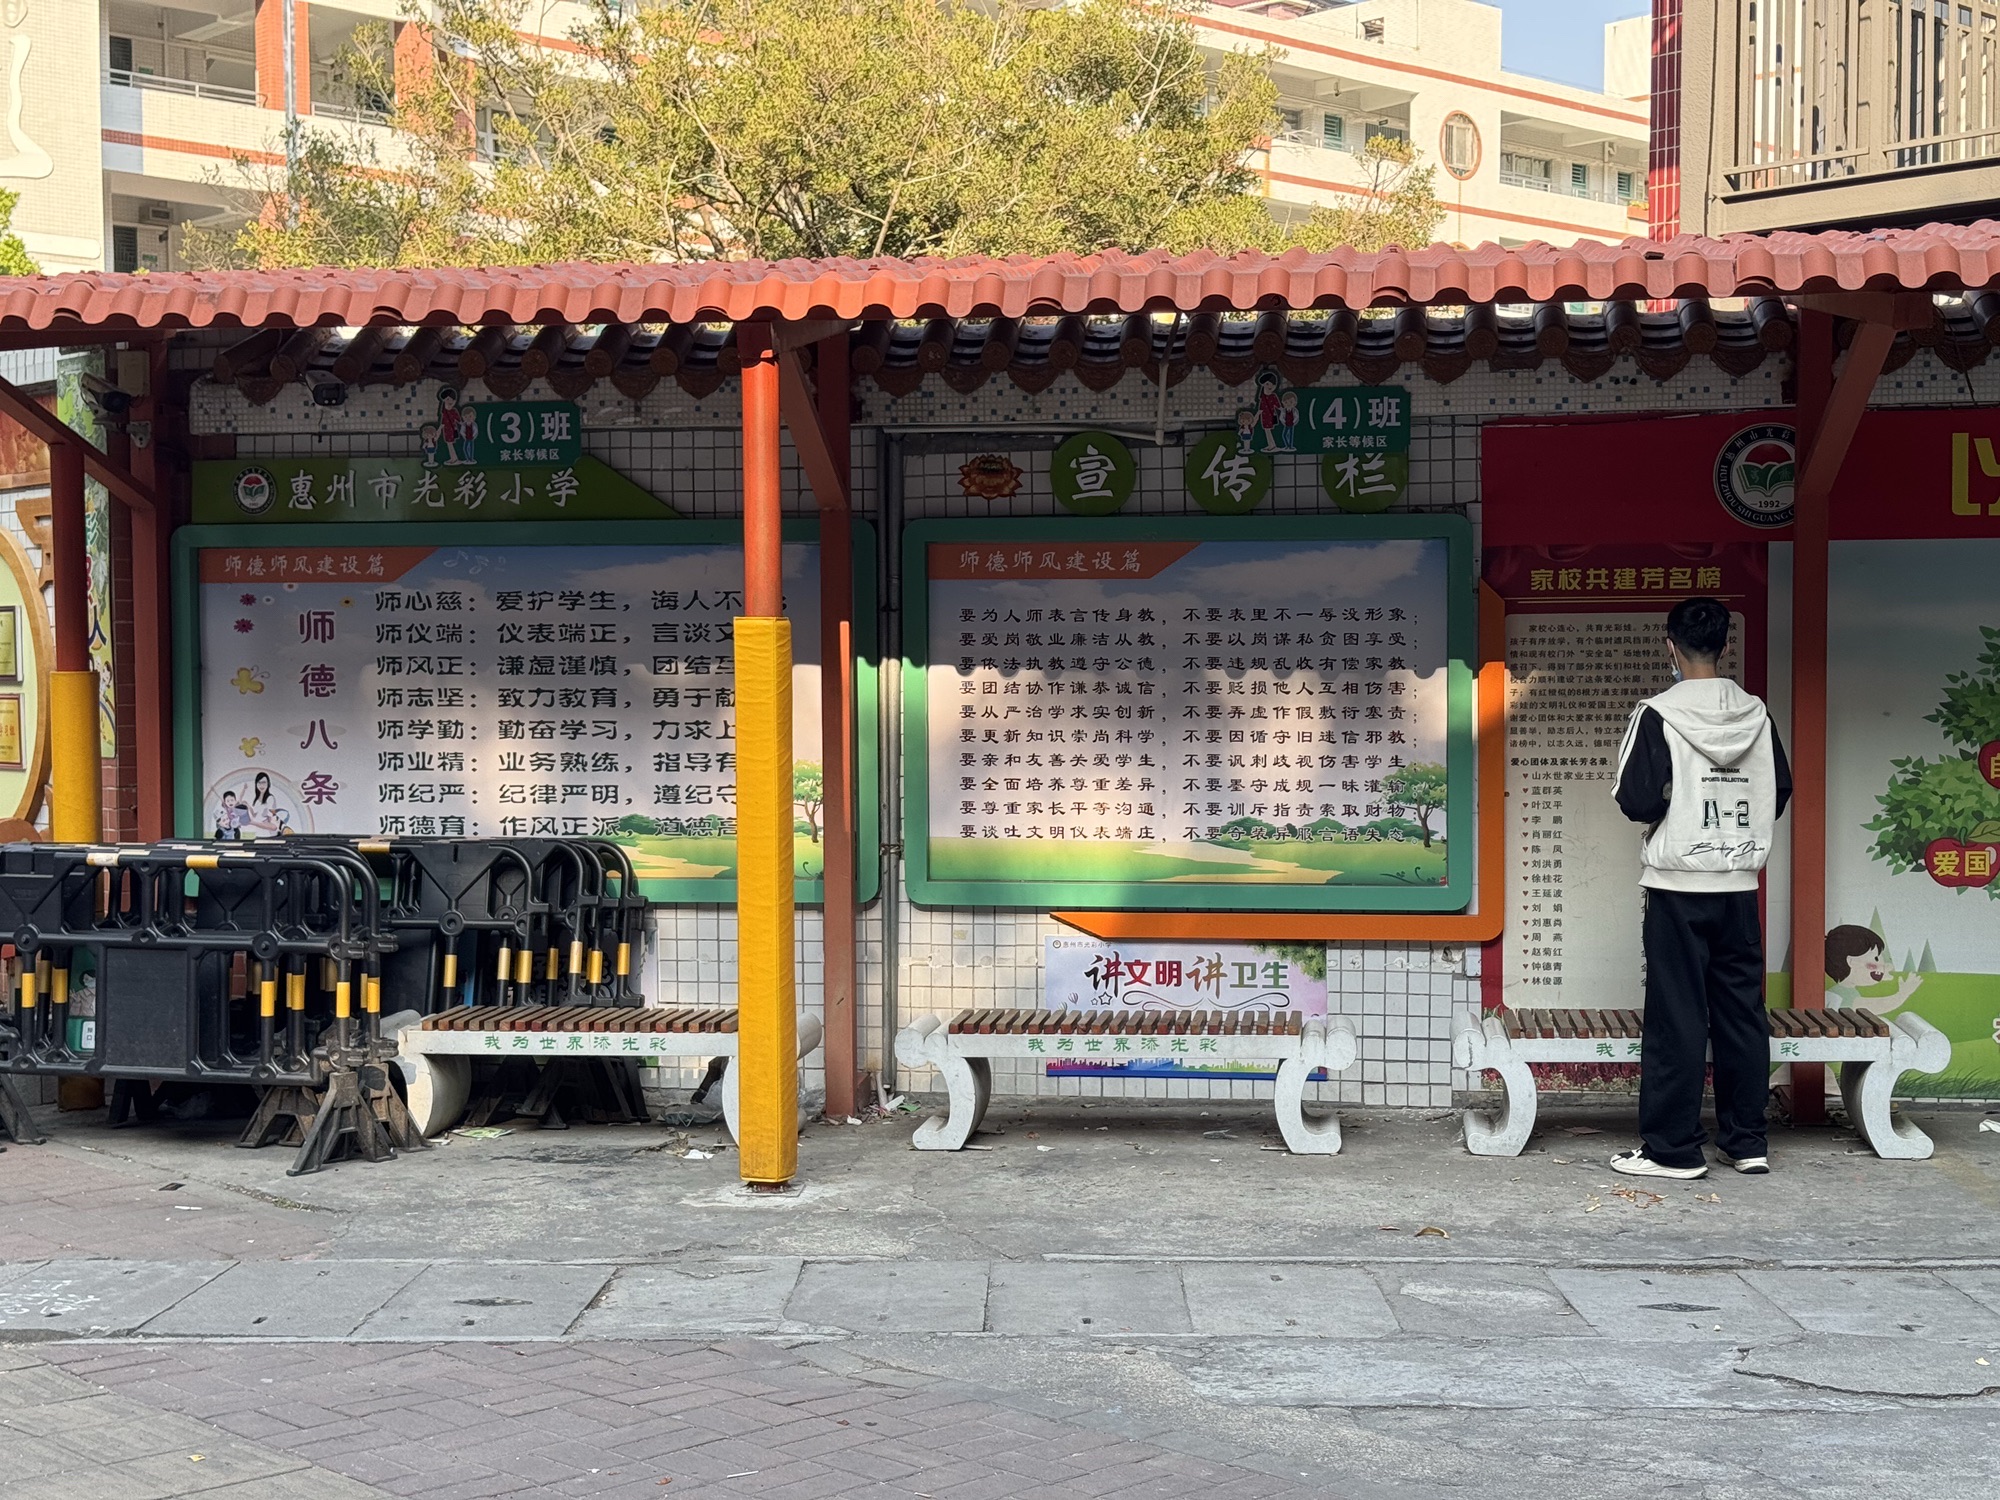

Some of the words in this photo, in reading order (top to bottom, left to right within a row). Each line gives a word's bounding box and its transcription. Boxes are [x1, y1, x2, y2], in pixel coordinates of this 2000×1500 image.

[1322, 435, 1388, 449] 家长等候区
[500, 448, 560, 461] 家长等候区
[288, 467, 581, 510] 惠州市光彩小学
[224, 554, 385, 578] 师德师风建设篇
[960, 549, 1142, 574] 师德师风建设篇
[1530, 567, 1722, 591] 家校共建芳名榜
[300, 610, 339, 806] 师德八条
[1531, 801, 1563, 810] 叶汉平
[1701, 798, 1751, 829] A-2
[1531, 830, 1563, 839] 肖丽红
[1531, 860, 1563, 869] 刘洪勇
[1933, 850, 1990, 877] 爱国
[1531, 874, 1563, 883] 徐桂花
[1531, 947, 1563, 956] 赵菊红
[1085, 951, 1290, 998] 讲文明讲卫生
[485, 1035, 667, 1052] 我为世界添光彩
[1028, 1037, 1218, 1053] 我为世界添光彩
